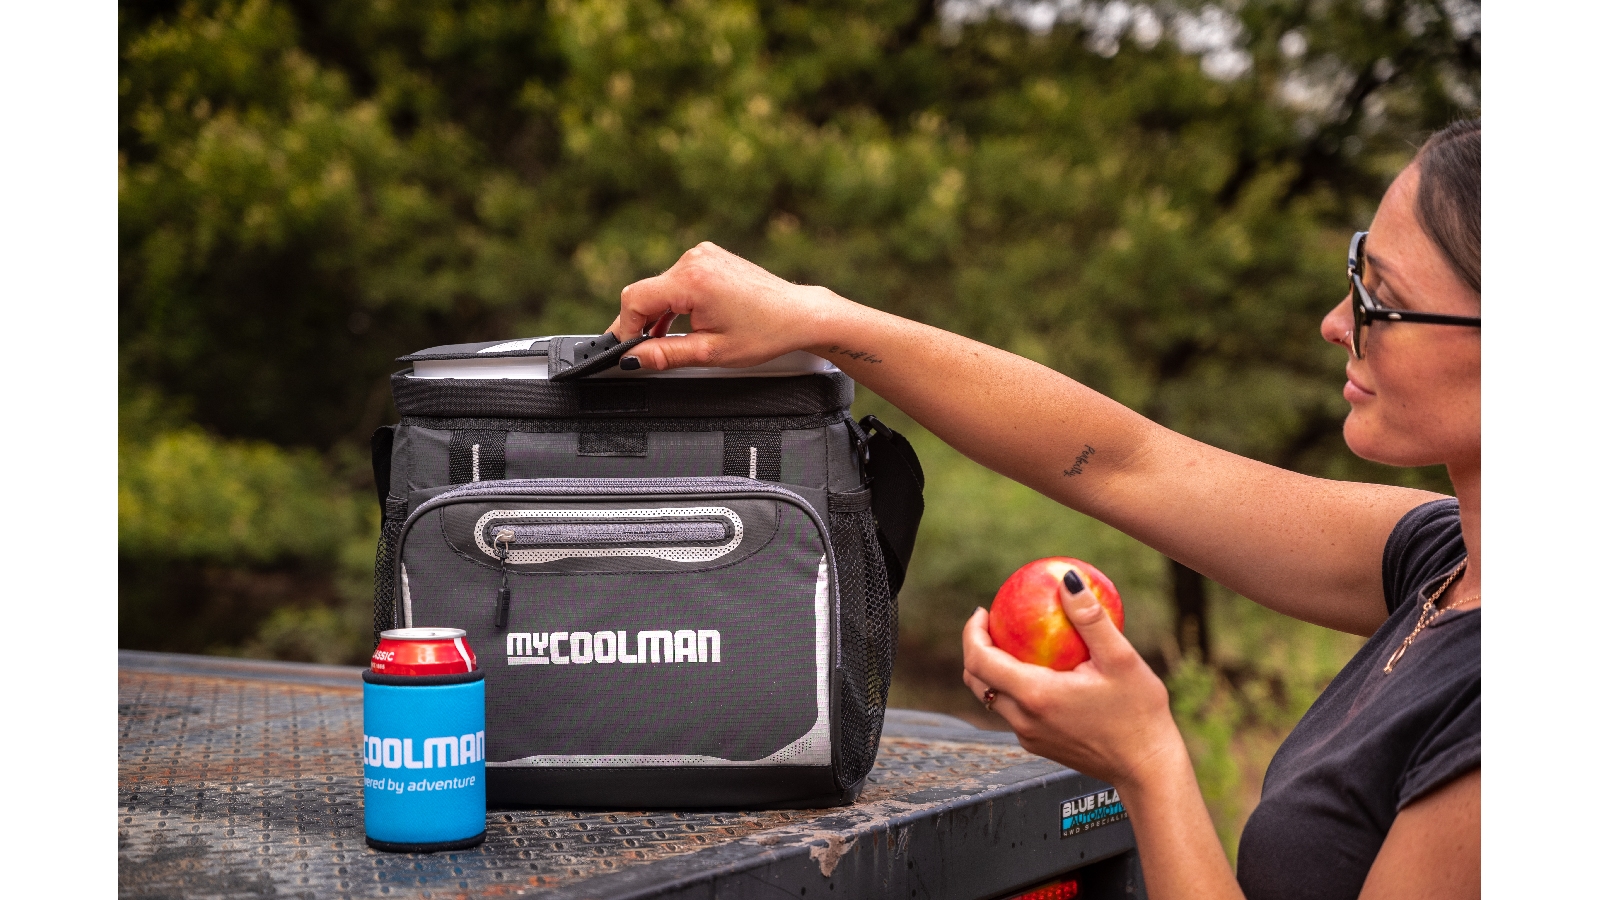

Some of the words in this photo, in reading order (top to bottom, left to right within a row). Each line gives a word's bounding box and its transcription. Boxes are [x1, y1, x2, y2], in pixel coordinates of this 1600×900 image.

[372, 649, 395, 662] ASSIC
[506, 629, 721, 666] MYCOOLMAN
[364, 777, 386, 790] ered
[387, 778, 404, 794] by
[407, 776, 476, 791] adventure
[1062, 795, 1095, 817] BLUE
